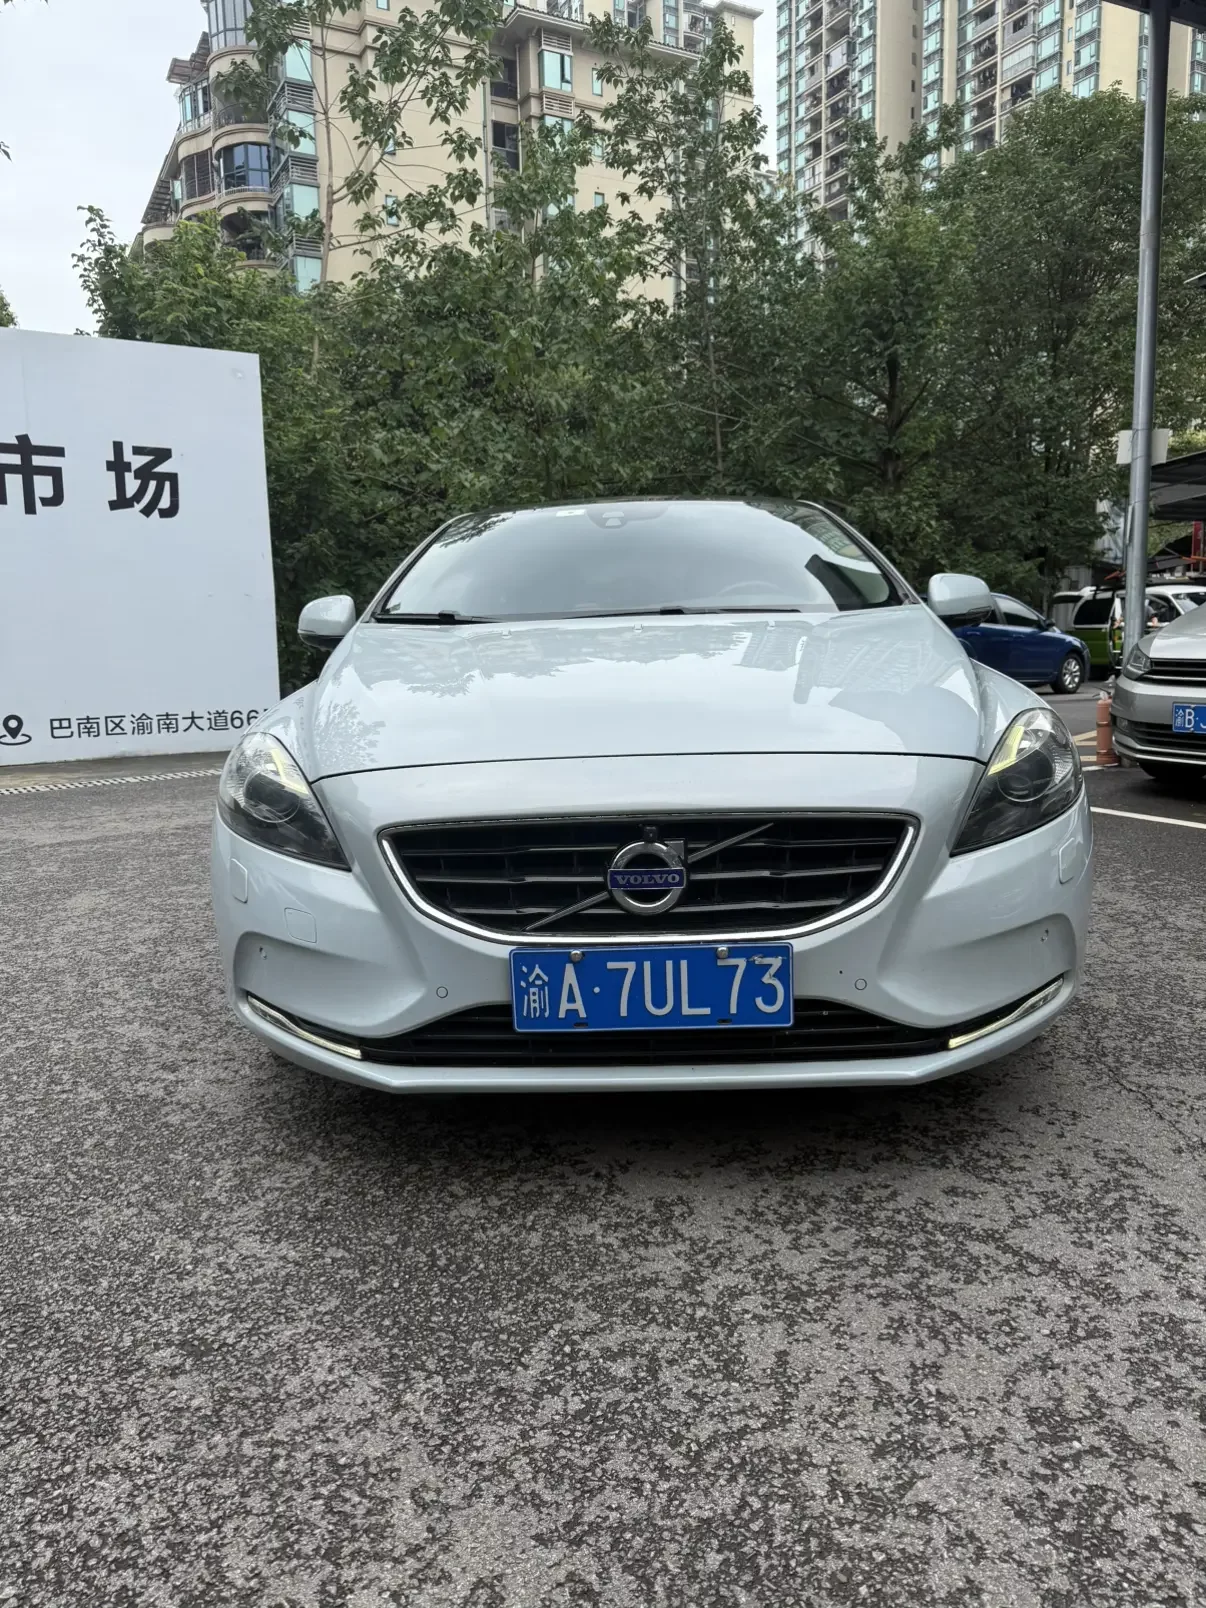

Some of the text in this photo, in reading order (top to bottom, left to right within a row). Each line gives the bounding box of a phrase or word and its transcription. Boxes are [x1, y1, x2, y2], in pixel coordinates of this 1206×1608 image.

[0, 433, 180, 519] 市场
[49, 709, 268, 739] 巴南区渝南大道66
[1175, 708, 1206, 728] 渝B·
[614, 873, 680, 886] VOLVO
